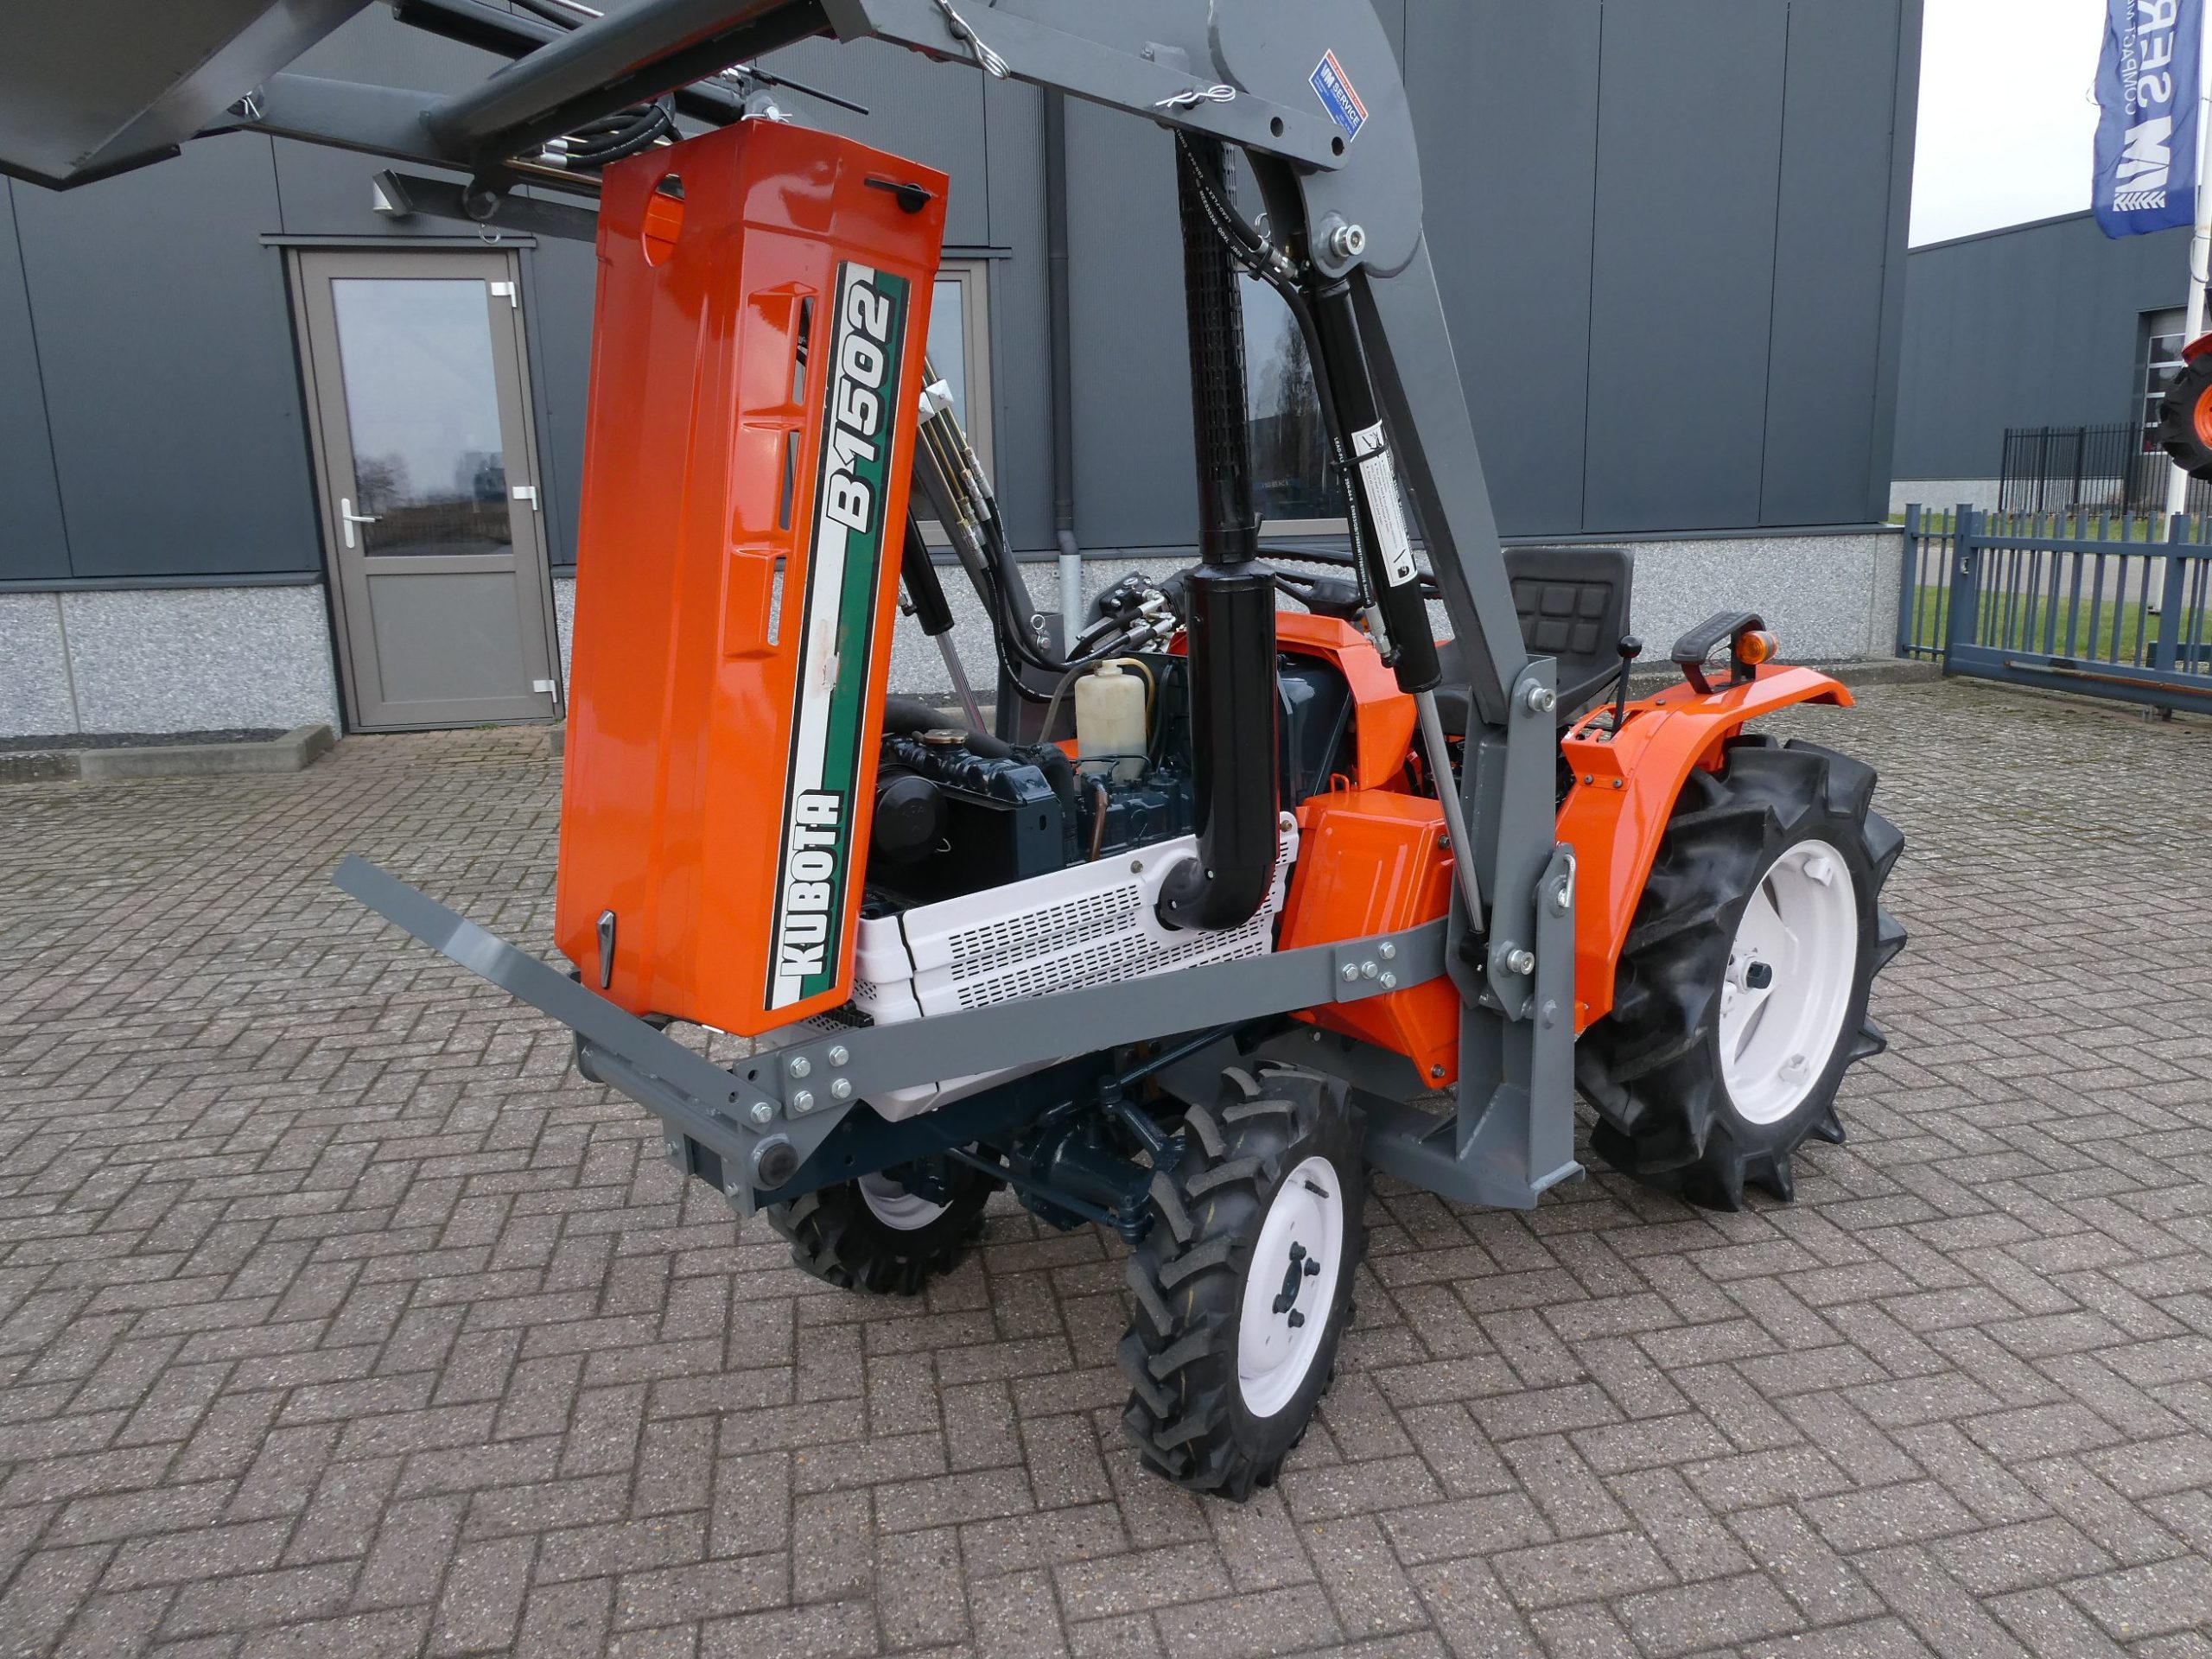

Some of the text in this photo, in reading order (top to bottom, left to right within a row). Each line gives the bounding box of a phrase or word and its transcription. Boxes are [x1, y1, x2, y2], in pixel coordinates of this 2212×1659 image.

[1332, 83, 1360, 127] SERVICE
[1334, 437, 1344, 464] LEAD-FLE
[780, 280, 893, 976] KUBOTA B1502
